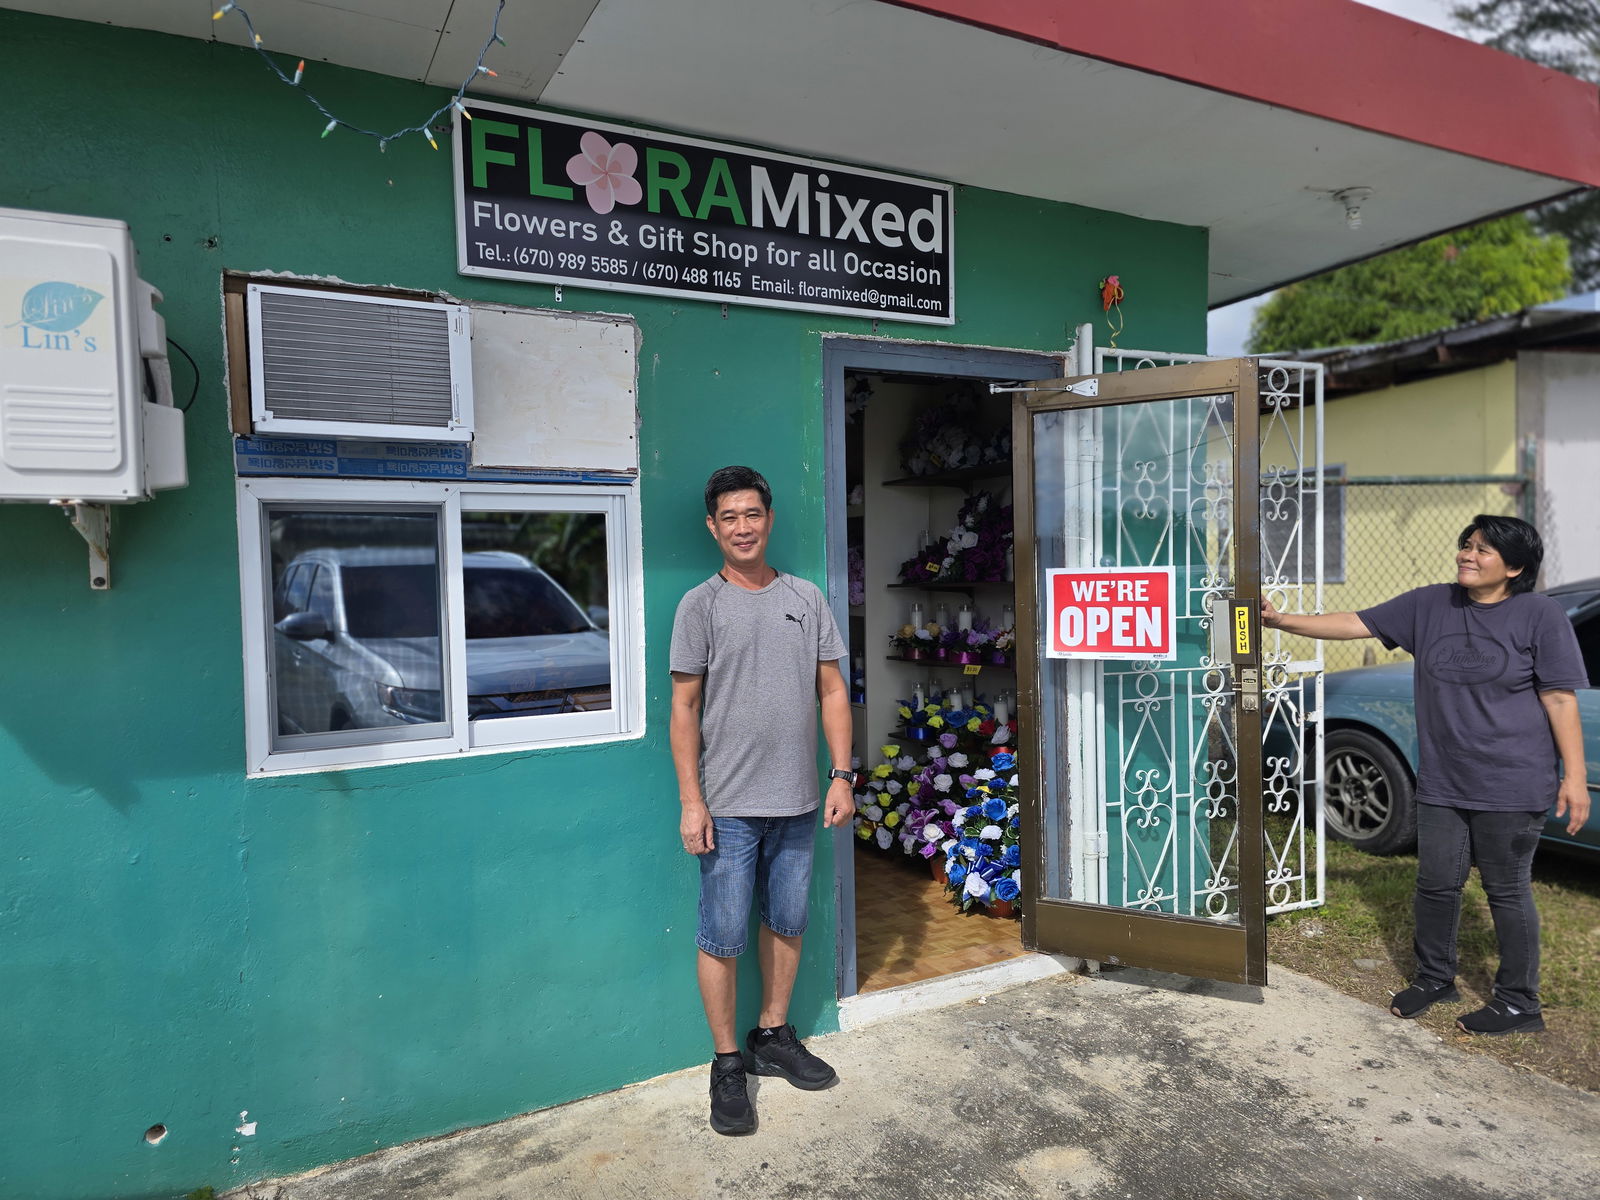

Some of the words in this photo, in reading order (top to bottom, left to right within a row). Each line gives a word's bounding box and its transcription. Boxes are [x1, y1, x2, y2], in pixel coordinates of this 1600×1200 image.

[473, 200, 598, 242] Flowers
[608, 220, 629, 247] &
[638, 223, 685, 254] Gift
[693, 231, 758, 267] Shop
[766, 241, 801, 268] for
[808, 248, 837, 273] all
[843, 251, 942, 286] Occasion
[475, 242, 511, 264] Tel.:
[513, 246, 555, 270] (670)
[557, 252, 586, 271] 989
[591, 256, 628, 276] 5585
[631, 260, 639, 277] /
[642, 262, 679, 283] (670)
[681, 268, 708, 285] 488
[712, 270, 742, 289] 1165
[751, 275, 795, 296] Email:
[798, 281, 943, 312] floramixed@gmail.com
[20, 325, 97, 353] Lin's
[1071, 580, 1149, 601] WE'RE
[1060, 606, 1162, 647] OPEN
[1238, 610, 1248, 650] PUSH
